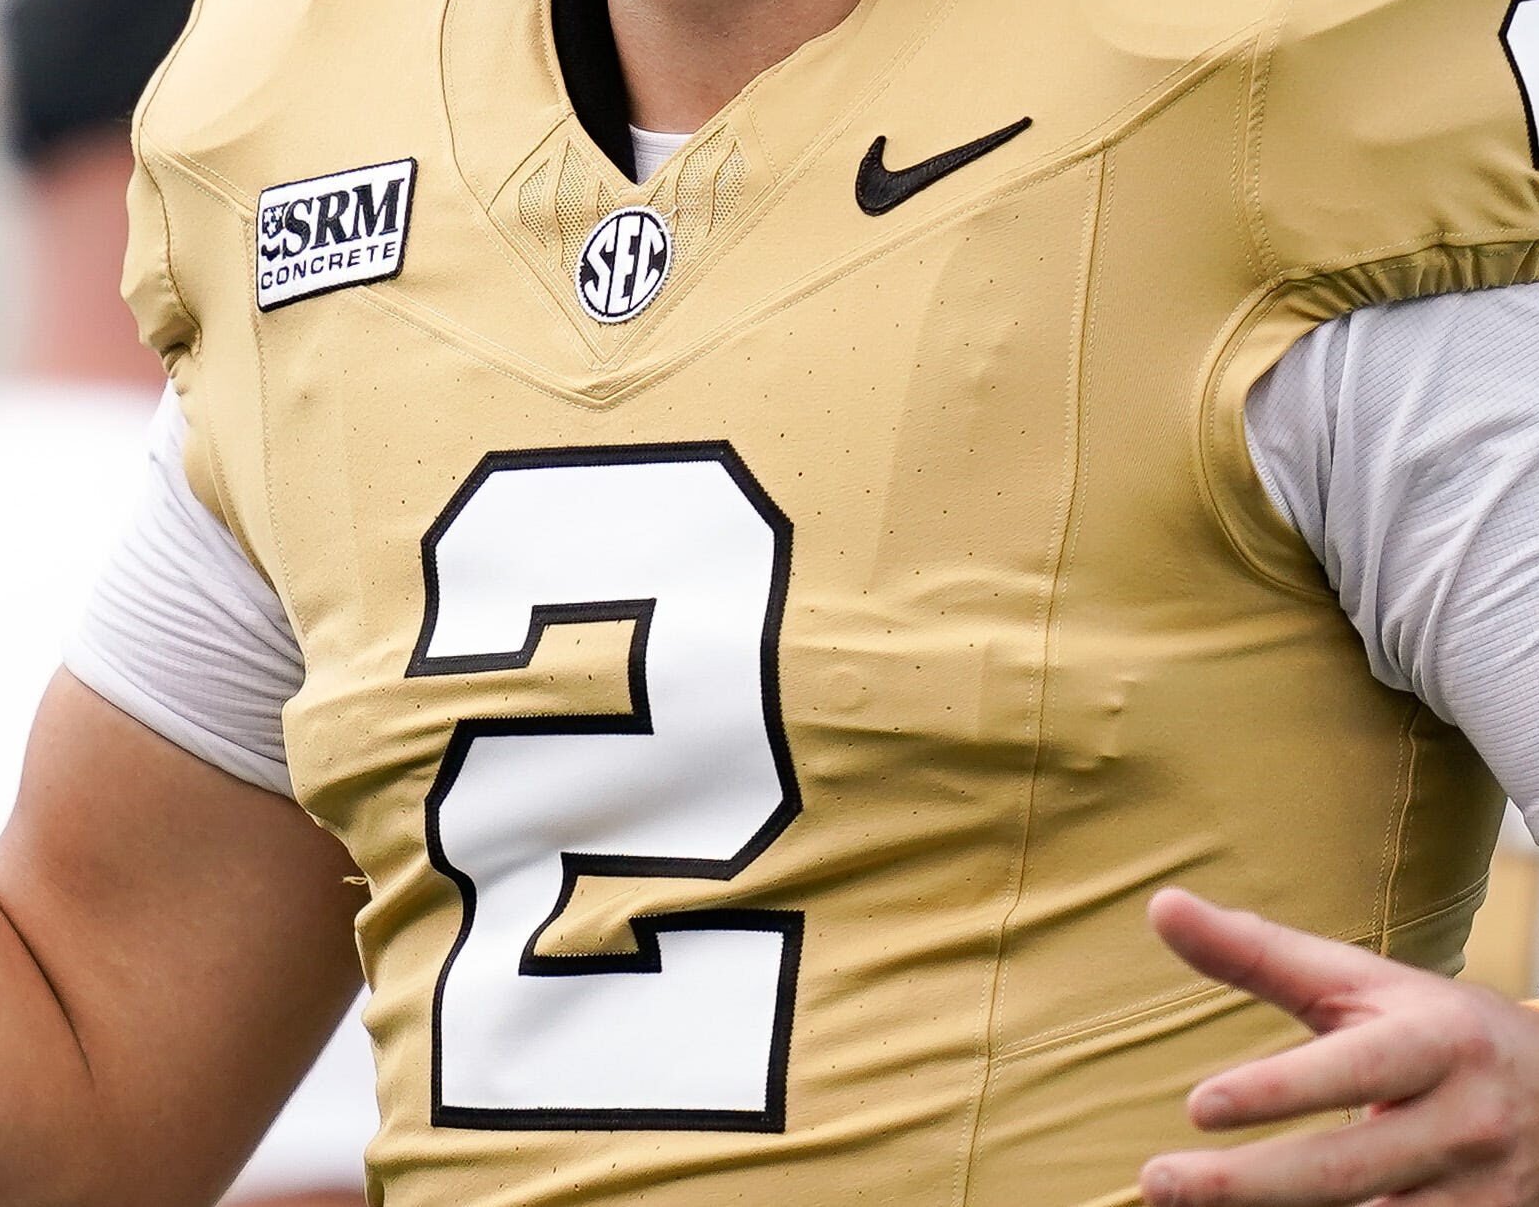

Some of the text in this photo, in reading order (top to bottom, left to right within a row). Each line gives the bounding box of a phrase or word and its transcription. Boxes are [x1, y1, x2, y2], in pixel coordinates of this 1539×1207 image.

[282, 178, 405, 260] SRM
[582, 214, 666, 314] SEC
[261, 241, 397, 290] CONCRETE
[405, 440, 804, 1133] 2
